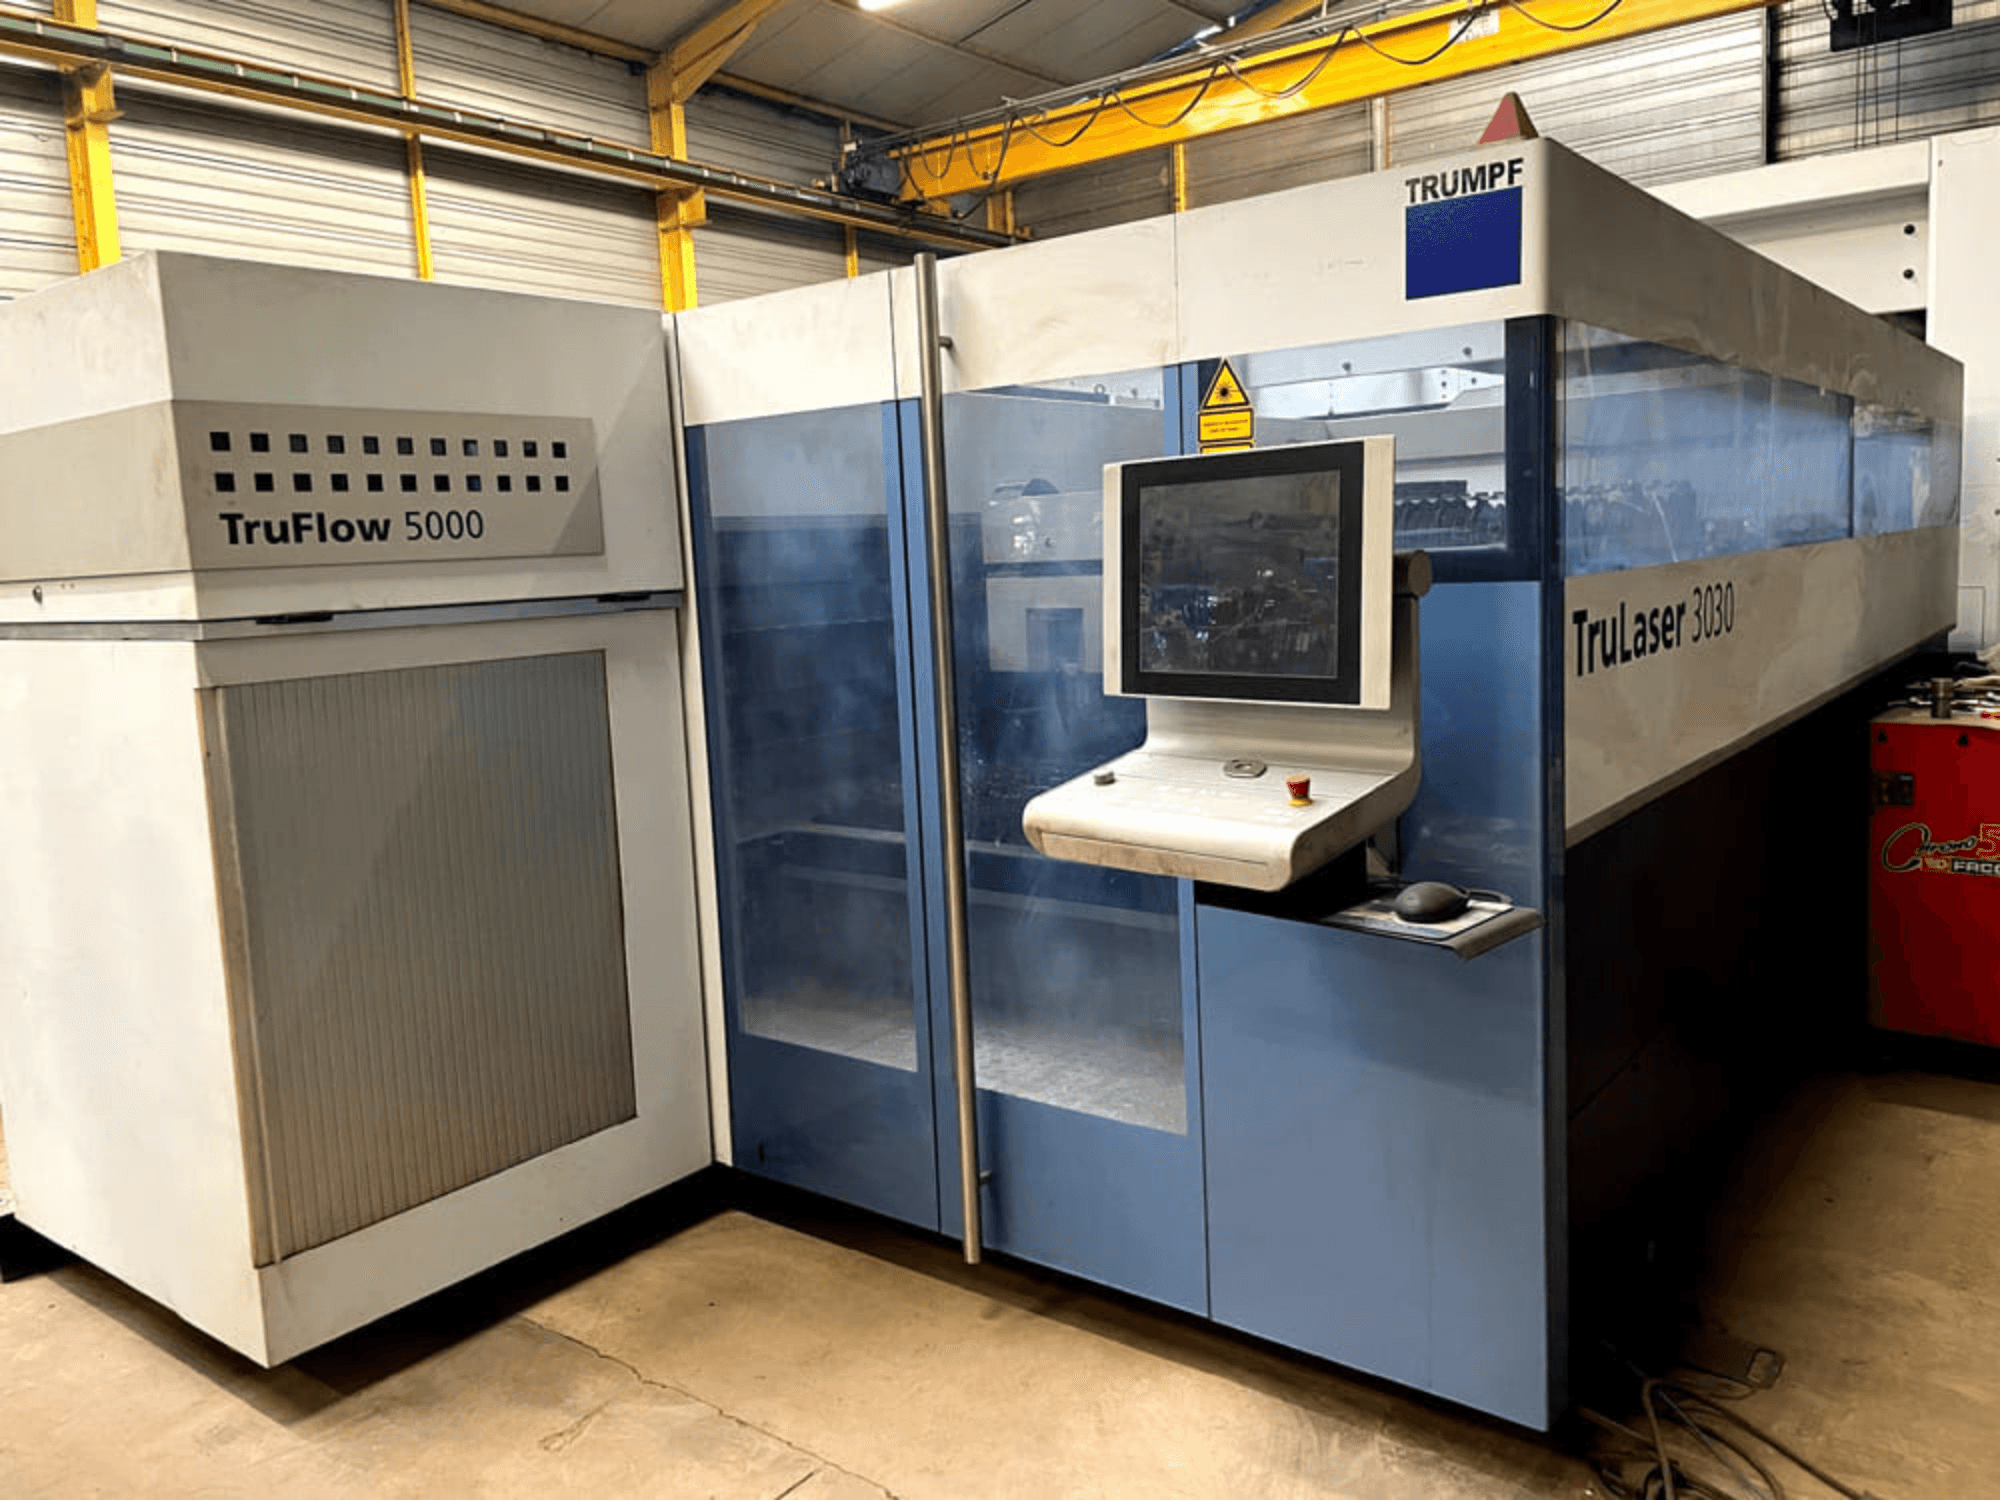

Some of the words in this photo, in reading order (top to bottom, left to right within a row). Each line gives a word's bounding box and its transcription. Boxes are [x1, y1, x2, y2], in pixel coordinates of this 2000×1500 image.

[1405, 157, 1524, 203] TRUMPF
[218, 512, 391, 545] TruFlow
[404, 509, 484, 541] 5000
[1572, 601, 1686, 677] TruLaser
[1692, 581, 1735, 643] 3030
